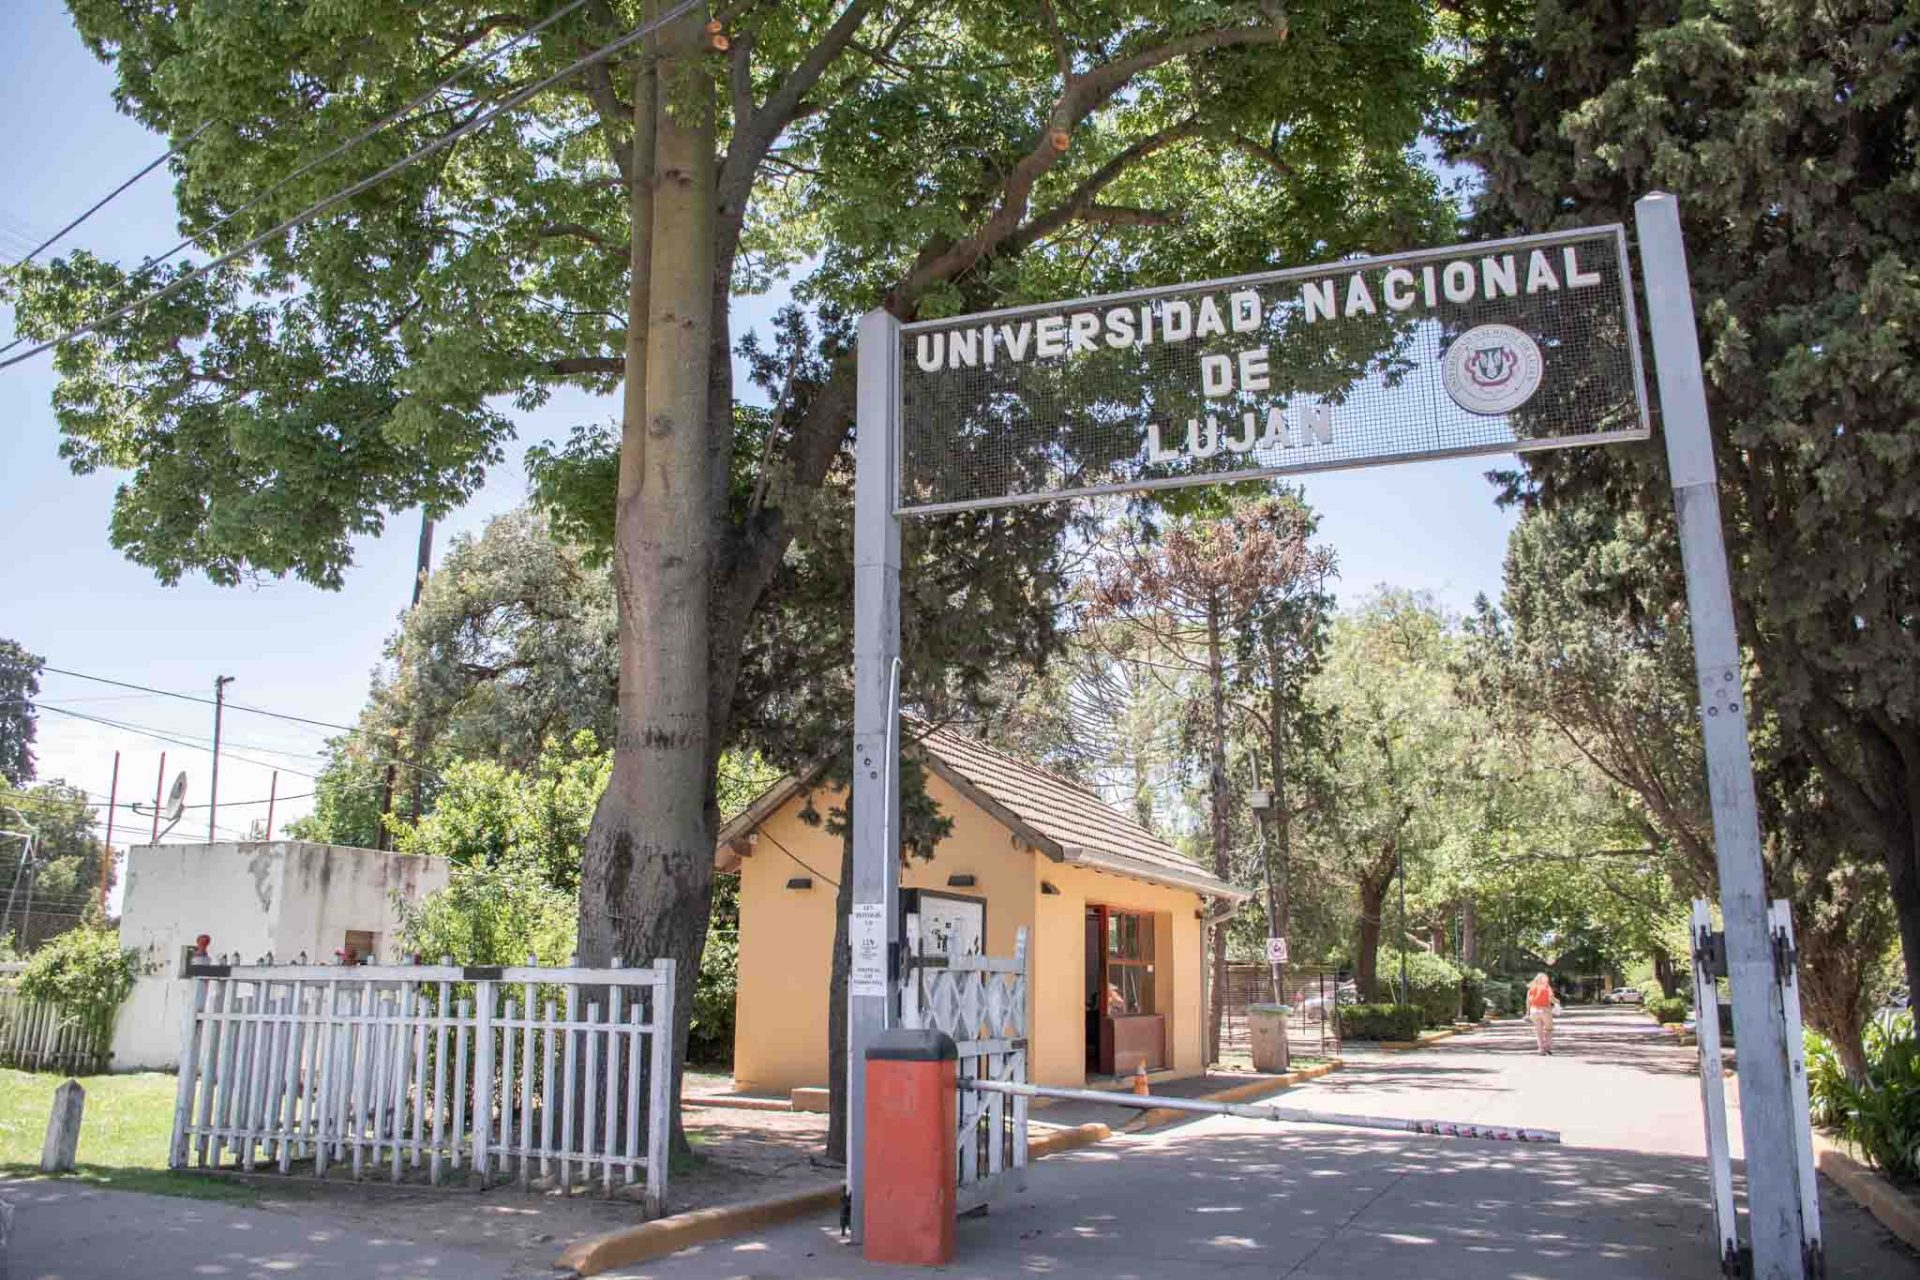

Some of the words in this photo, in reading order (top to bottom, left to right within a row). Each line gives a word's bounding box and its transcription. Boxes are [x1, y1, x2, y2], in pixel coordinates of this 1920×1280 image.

[917, 289, 1262, 373] UNIVERSIDAD
[1302, 247, 1600, 323] NACIONAL
[1201, 349, 1271, 398] DE
[1148, 403, 1332, 465] LUJAN
